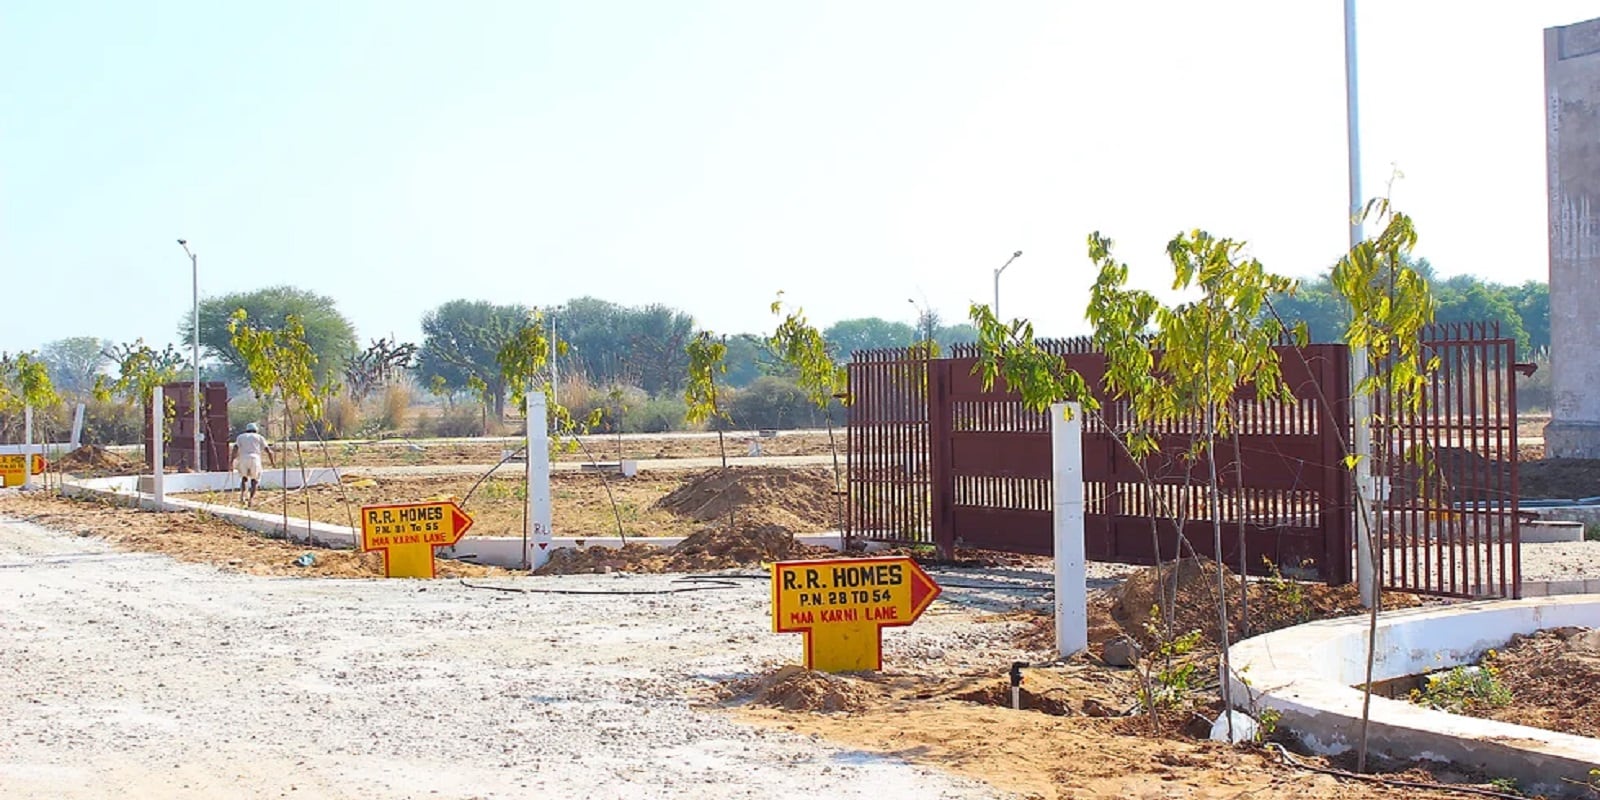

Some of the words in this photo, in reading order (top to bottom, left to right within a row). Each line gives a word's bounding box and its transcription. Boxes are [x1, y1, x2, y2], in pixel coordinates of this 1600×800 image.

[369, 511, 395, 524] R.R.
[400, 507, 442, 522] HOMES
[426, 523, 439, 531] 55
[393, 535, 420, 544] KARNI
[424, 533, 446, 543] LANE
[833, 565, 902, 587] HOMES
[800, 593, 825, 607] P.N.
[828, 592, 847, 605] 28
[851, 591, 869, 604] TO
[873, 589, 891, 602] 54
[790, 611, 814, 624] MAA
[821, 609, 858, 623] KARNI
[866, 606, 898, 621] LANE
